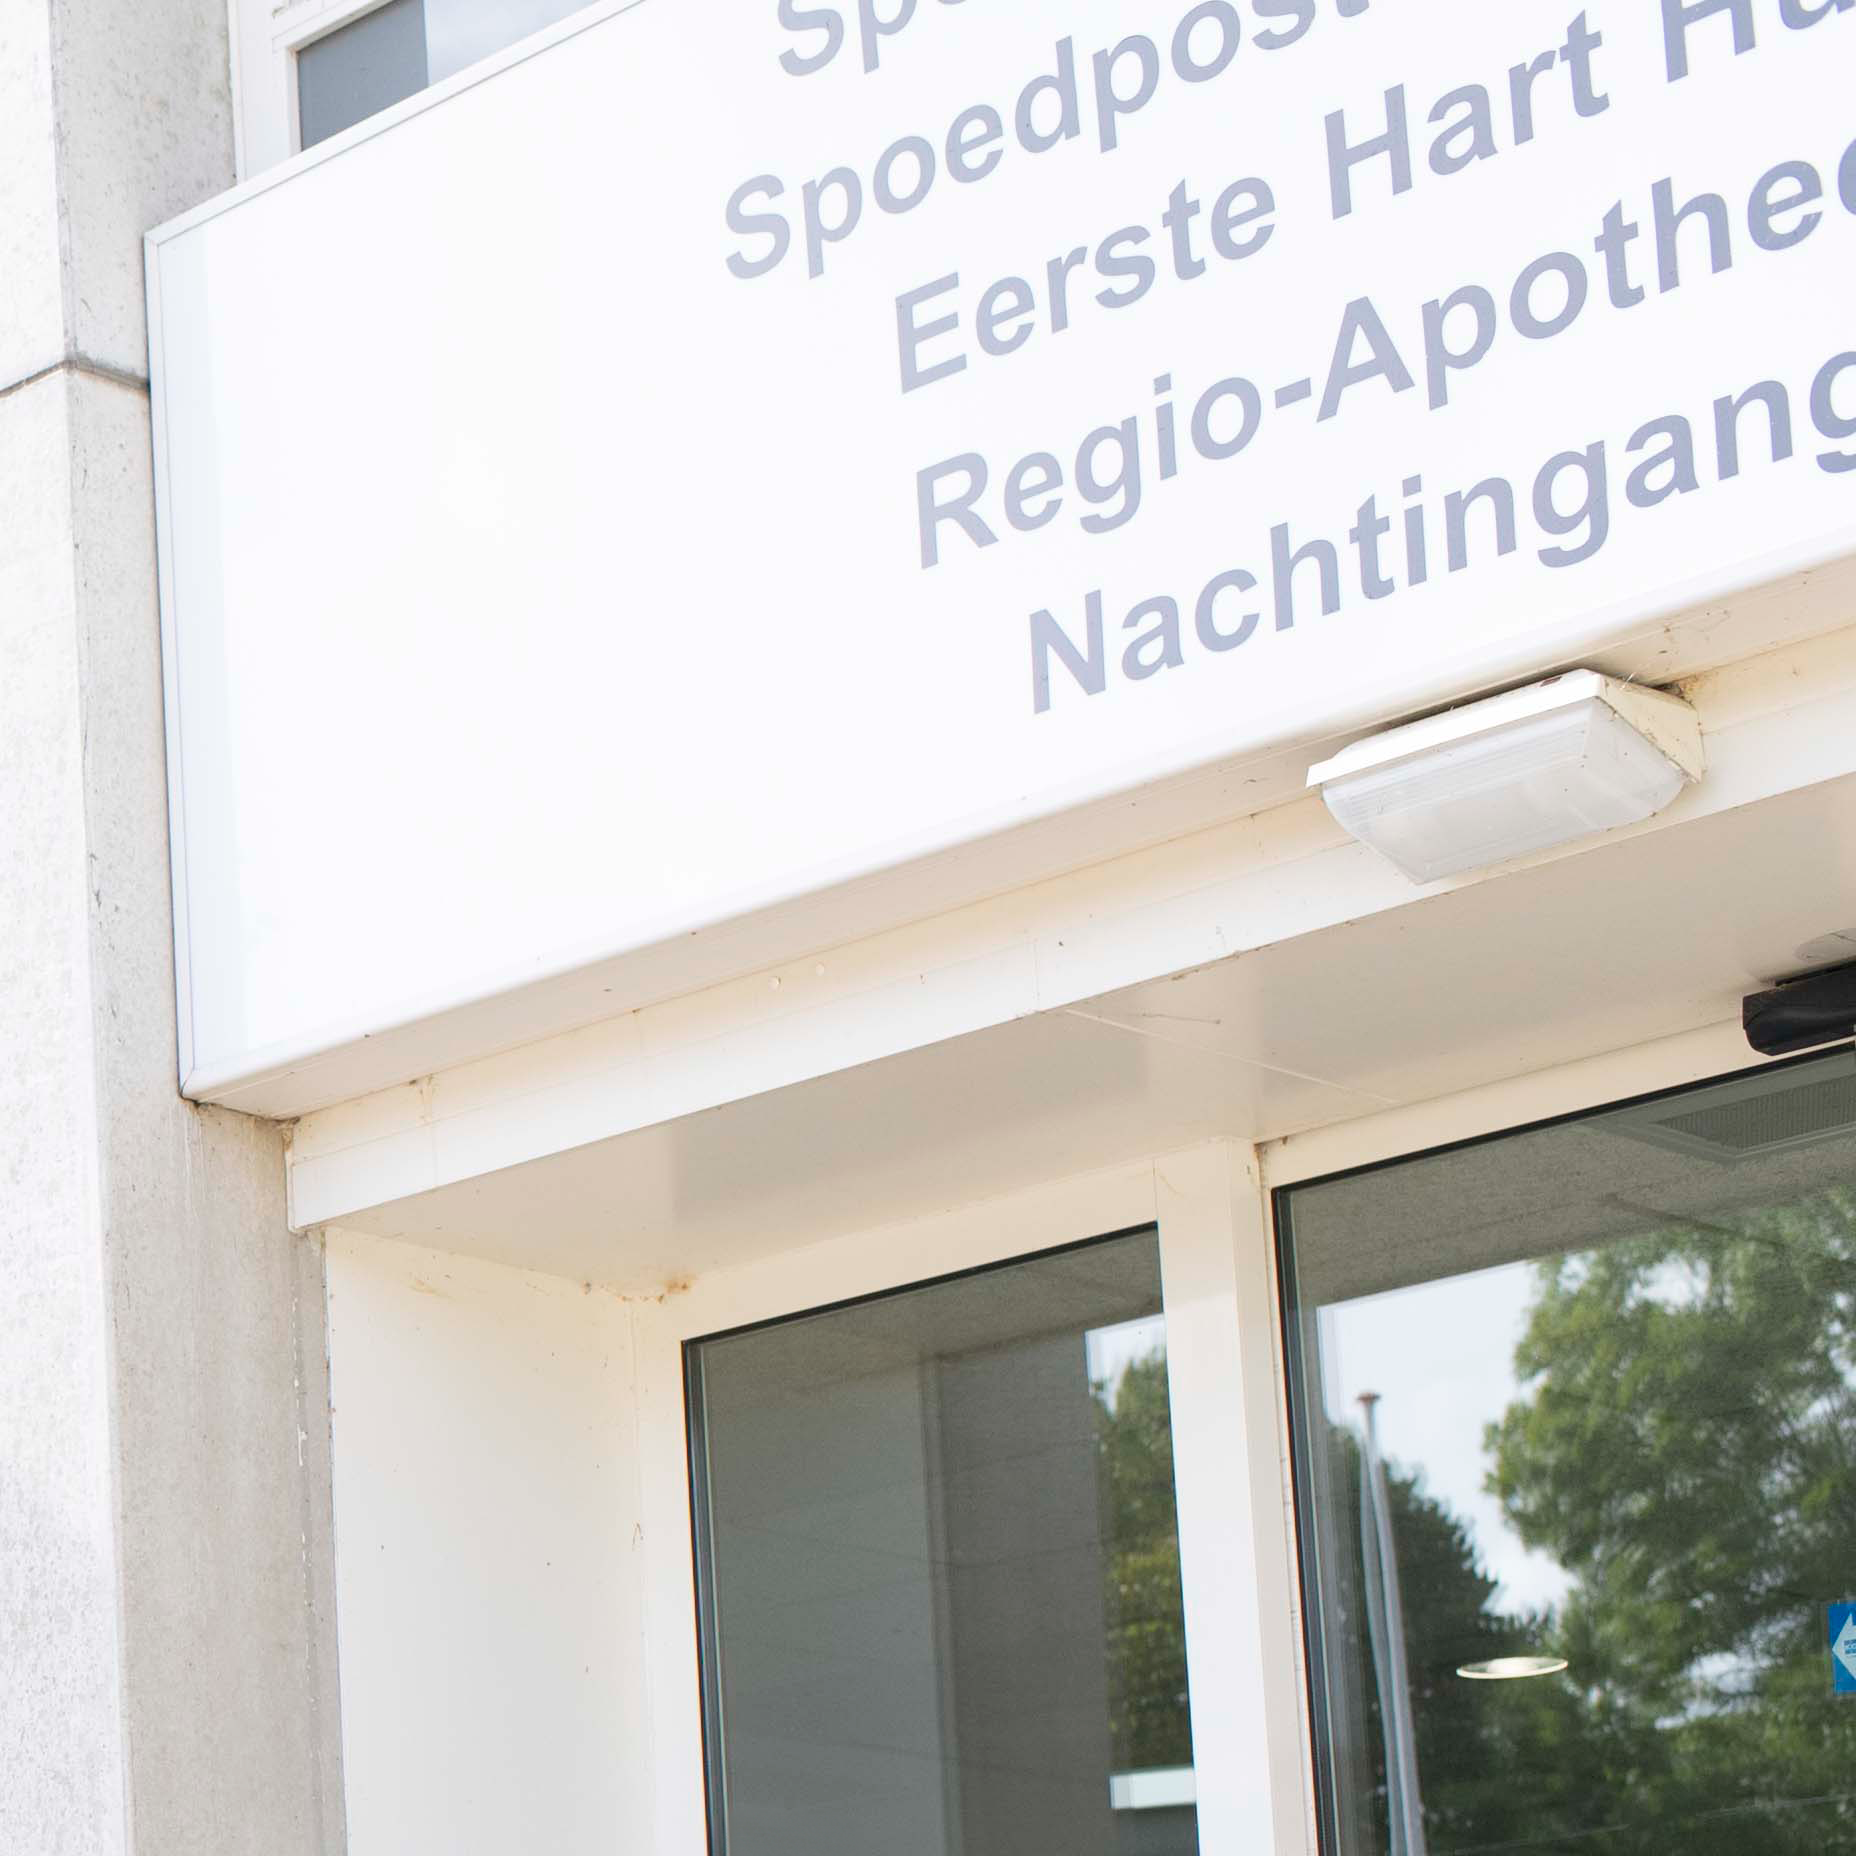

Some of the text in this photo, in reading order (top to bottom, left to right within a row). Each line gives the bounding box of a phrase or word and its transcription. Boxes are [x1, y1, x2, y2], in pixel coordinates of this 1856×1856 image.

[726, 0, 1369, 279] Spoedpos
[895, 177, 1275, 394] Eerste
[1324, 9, 1610, 220] Hart
[917, 138, 1856, 569] Regio-Apothe
